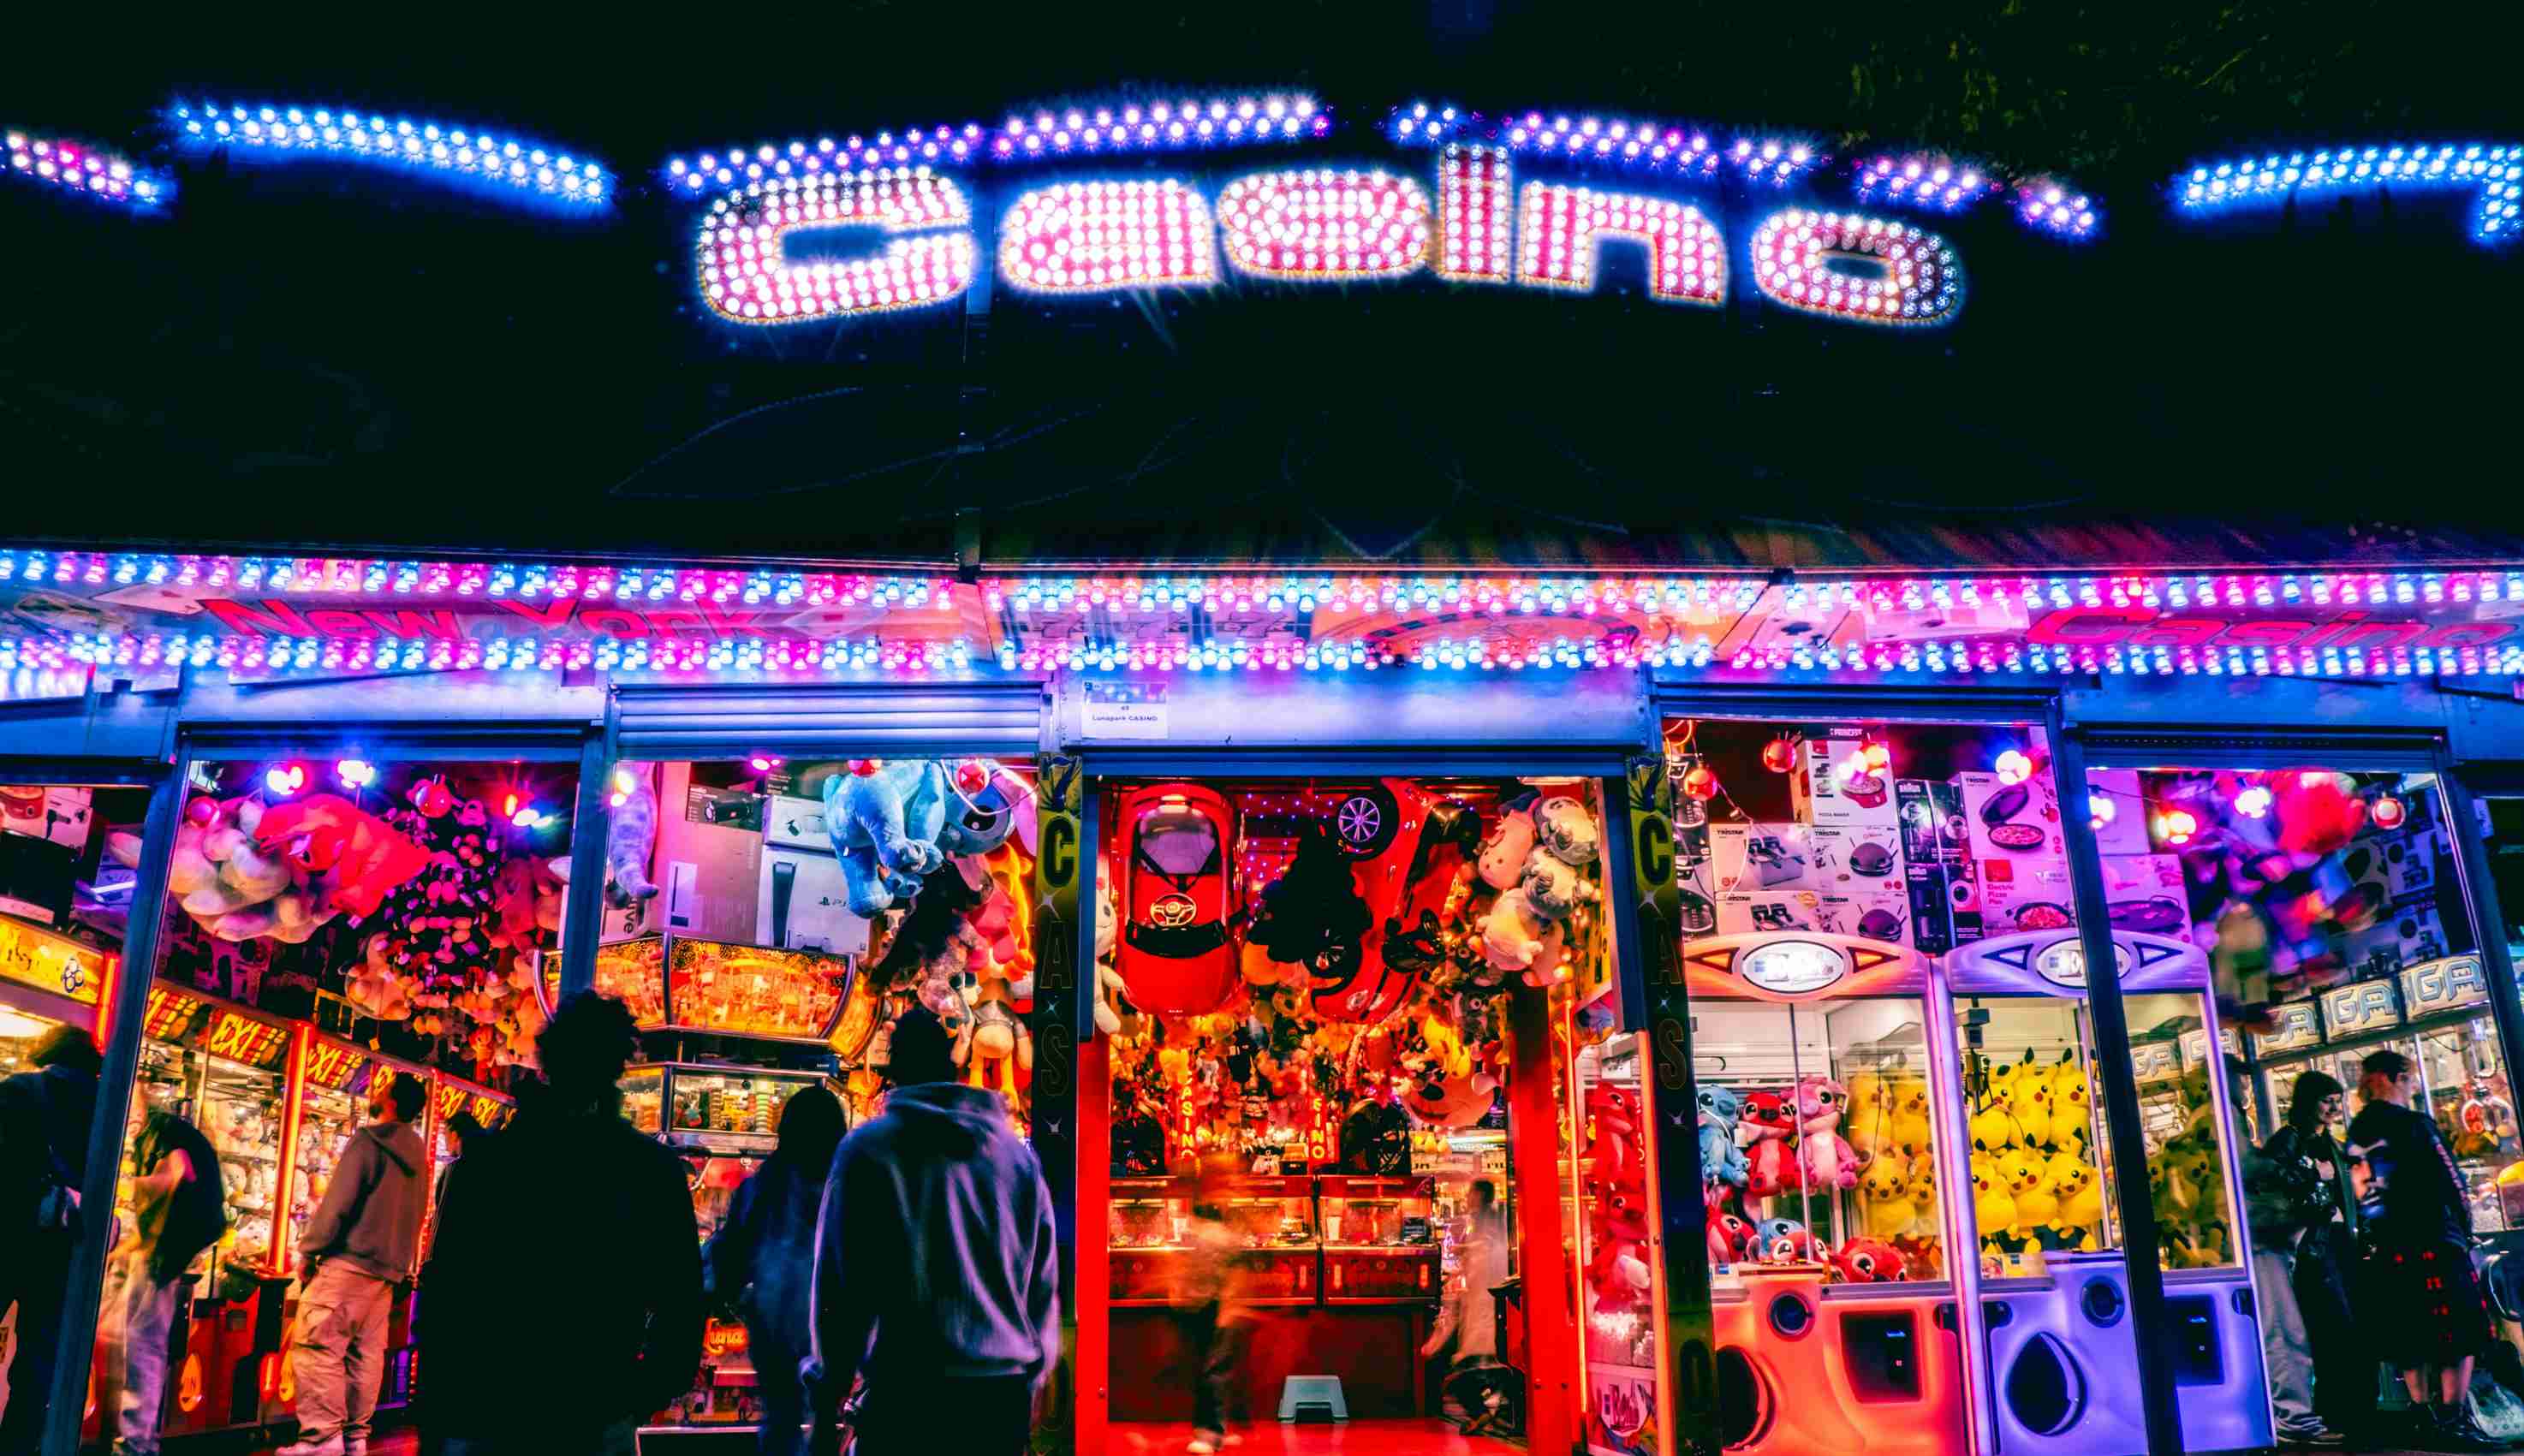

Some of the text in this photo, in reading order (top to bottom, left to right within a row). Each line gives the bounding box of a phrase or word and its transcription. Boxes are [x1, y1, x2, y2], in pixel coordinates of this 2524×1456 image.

[201, 597, 769, 639] New York
[2025, 605, 2521, 648] Casino
